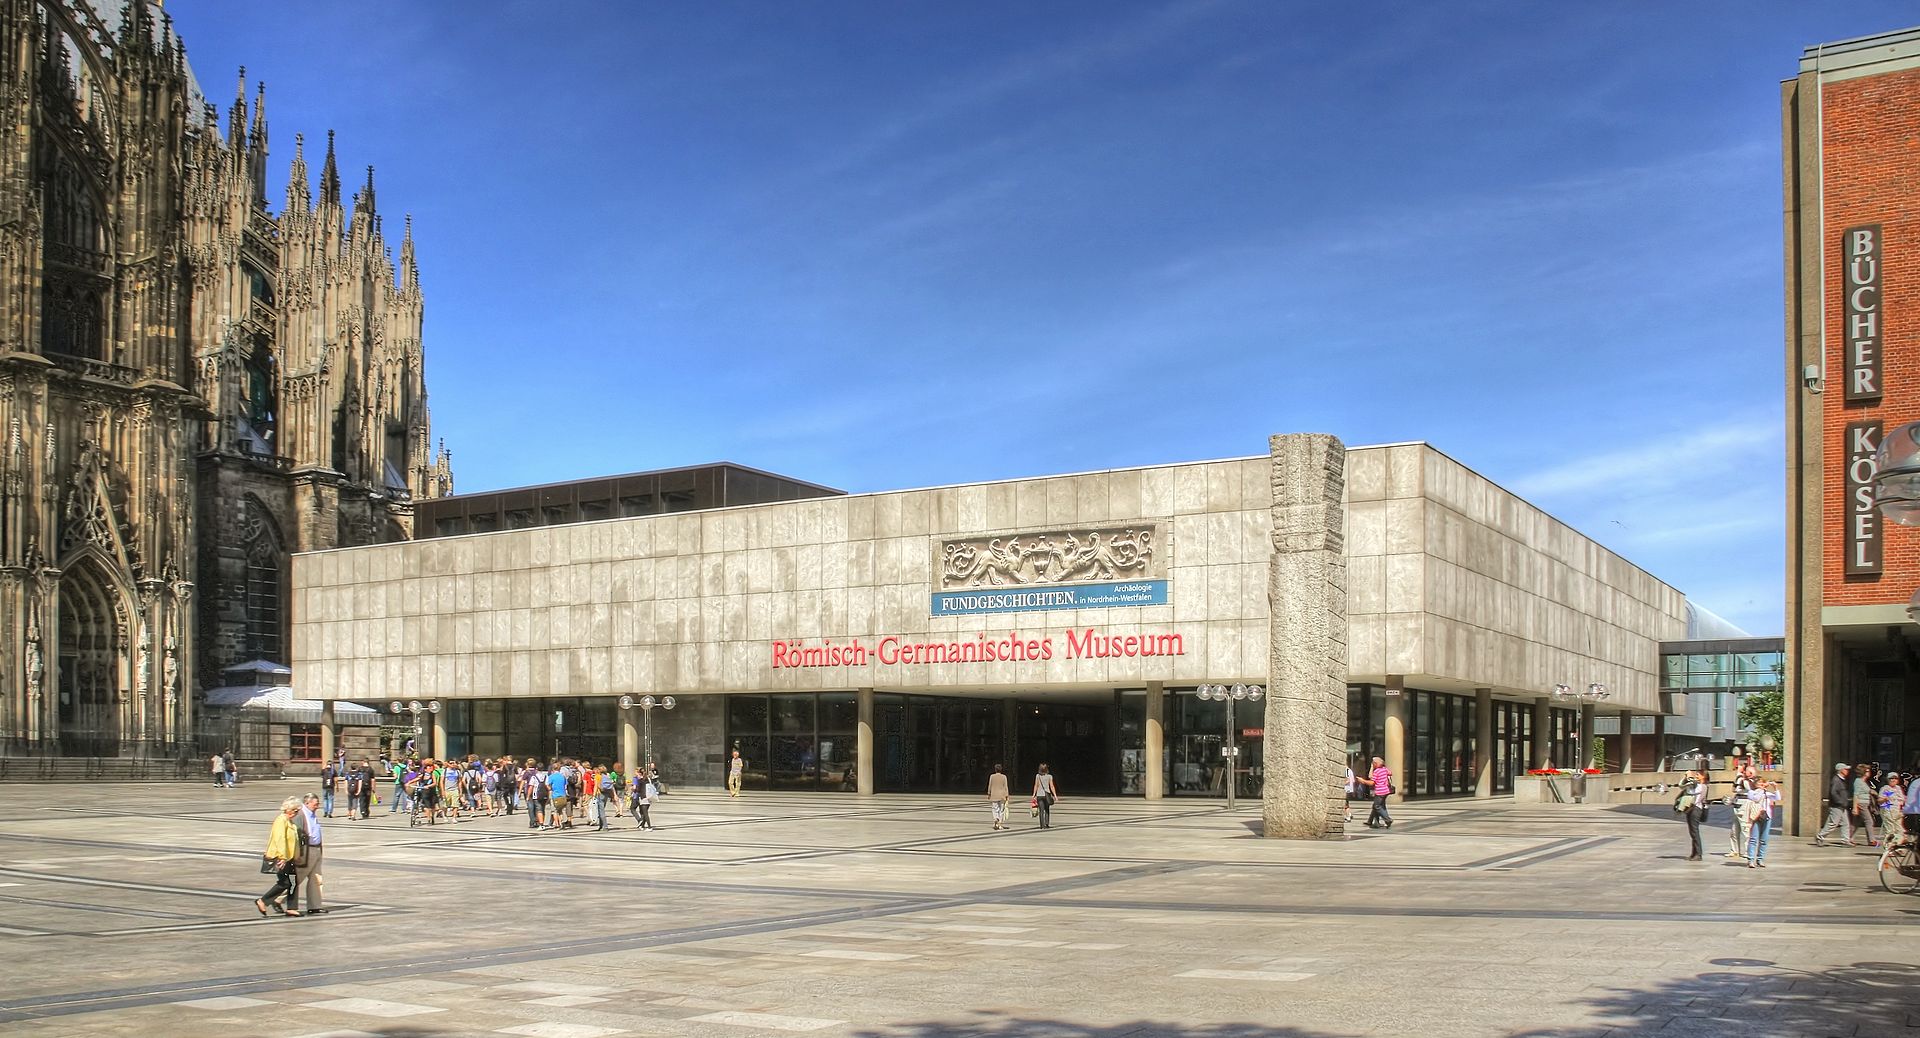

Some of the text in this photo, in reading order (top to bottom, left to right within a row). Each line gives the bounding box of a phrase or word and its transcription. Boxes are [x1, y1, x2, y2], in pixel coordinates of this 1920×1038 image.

[1851, 230, 1877, 394] BÜCHER
[1850, 428, 1877, 567] KÖSEL
[941, 590, 1078, 611] FUNDGESCHICHTEN.
[1087, 593, 1153, 604] Nordrhein-Westfalen
[1113, 584, 1153, 593] Archäologie
[772, 628, 1186, 668] Römisch-Germanisches Museum
